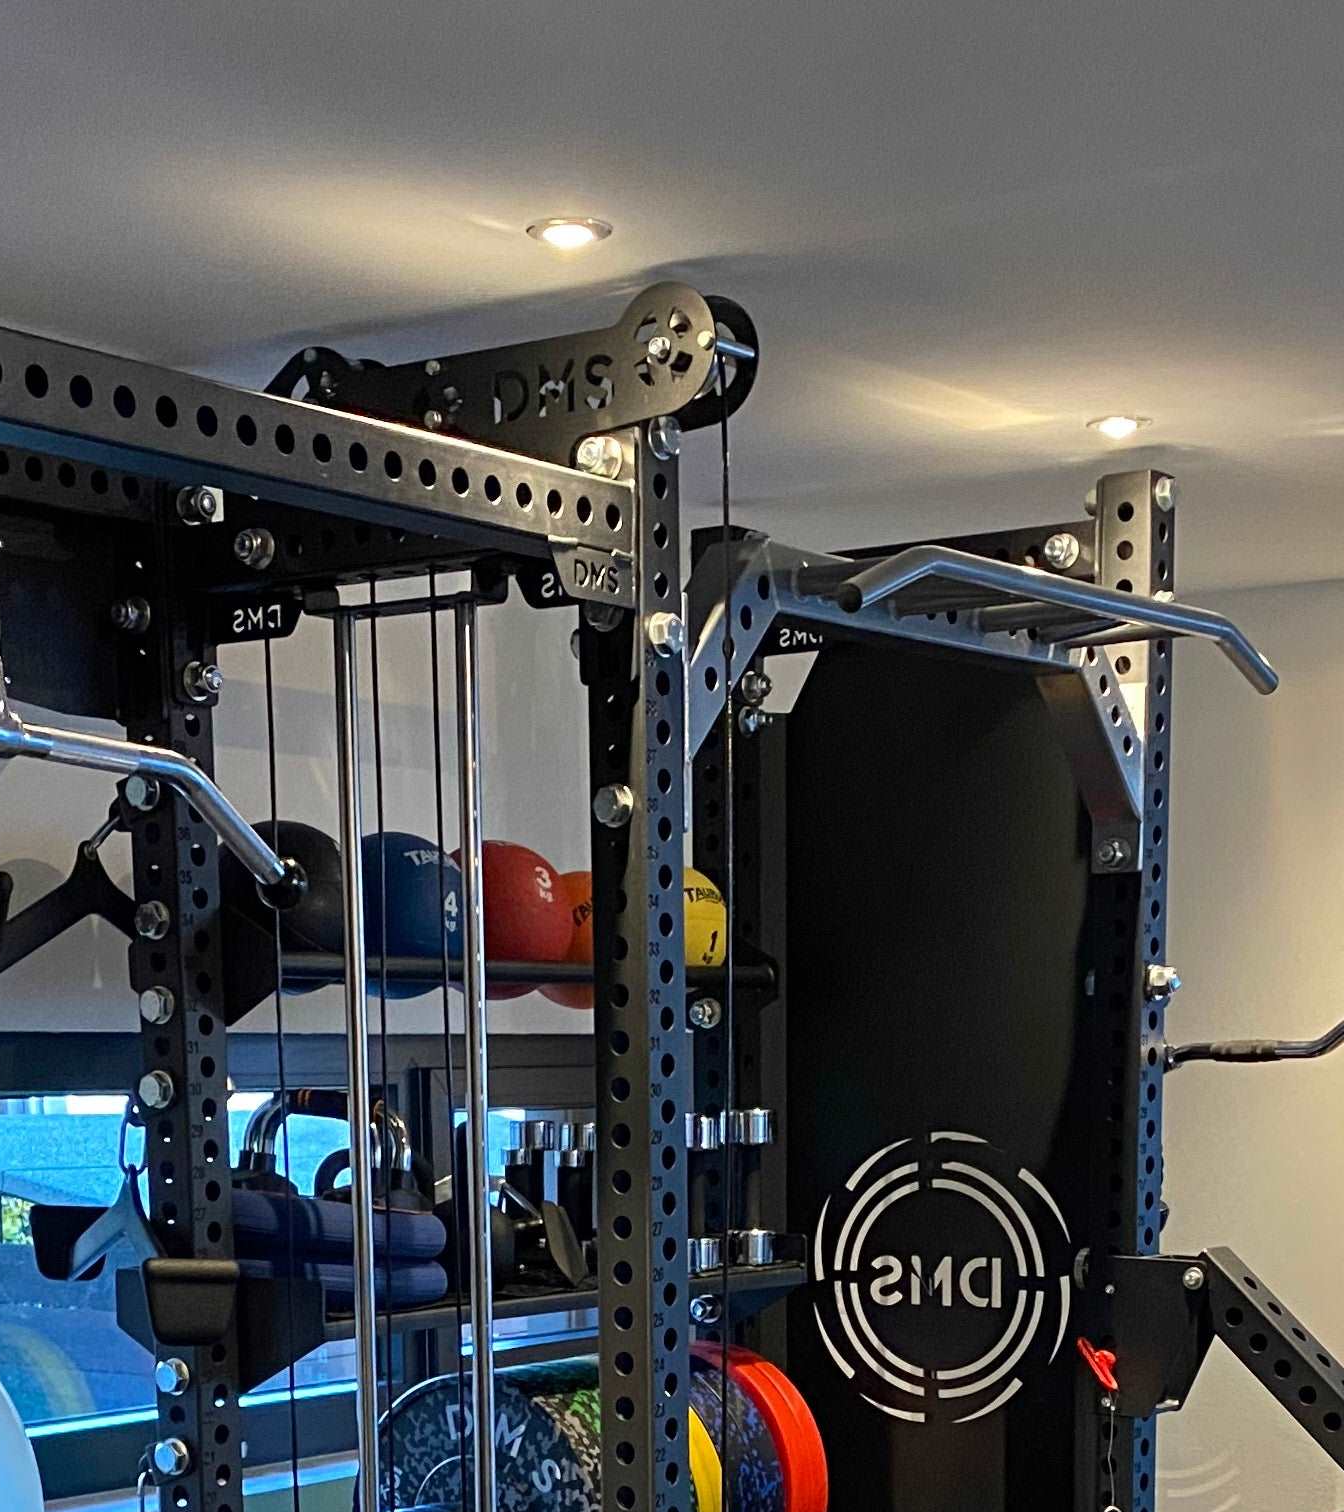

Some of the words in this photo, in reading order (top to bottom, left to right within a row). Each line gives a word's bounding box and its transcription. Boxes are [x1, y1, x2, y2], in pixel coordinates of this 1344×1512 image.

[493, 354, 616, 424] DMS
[574, 559, 620, 594] DMS
[534, 866, 552, 889] 3
[444, 891, 458, 917] 4
[709, 930, 718, 952] 1
